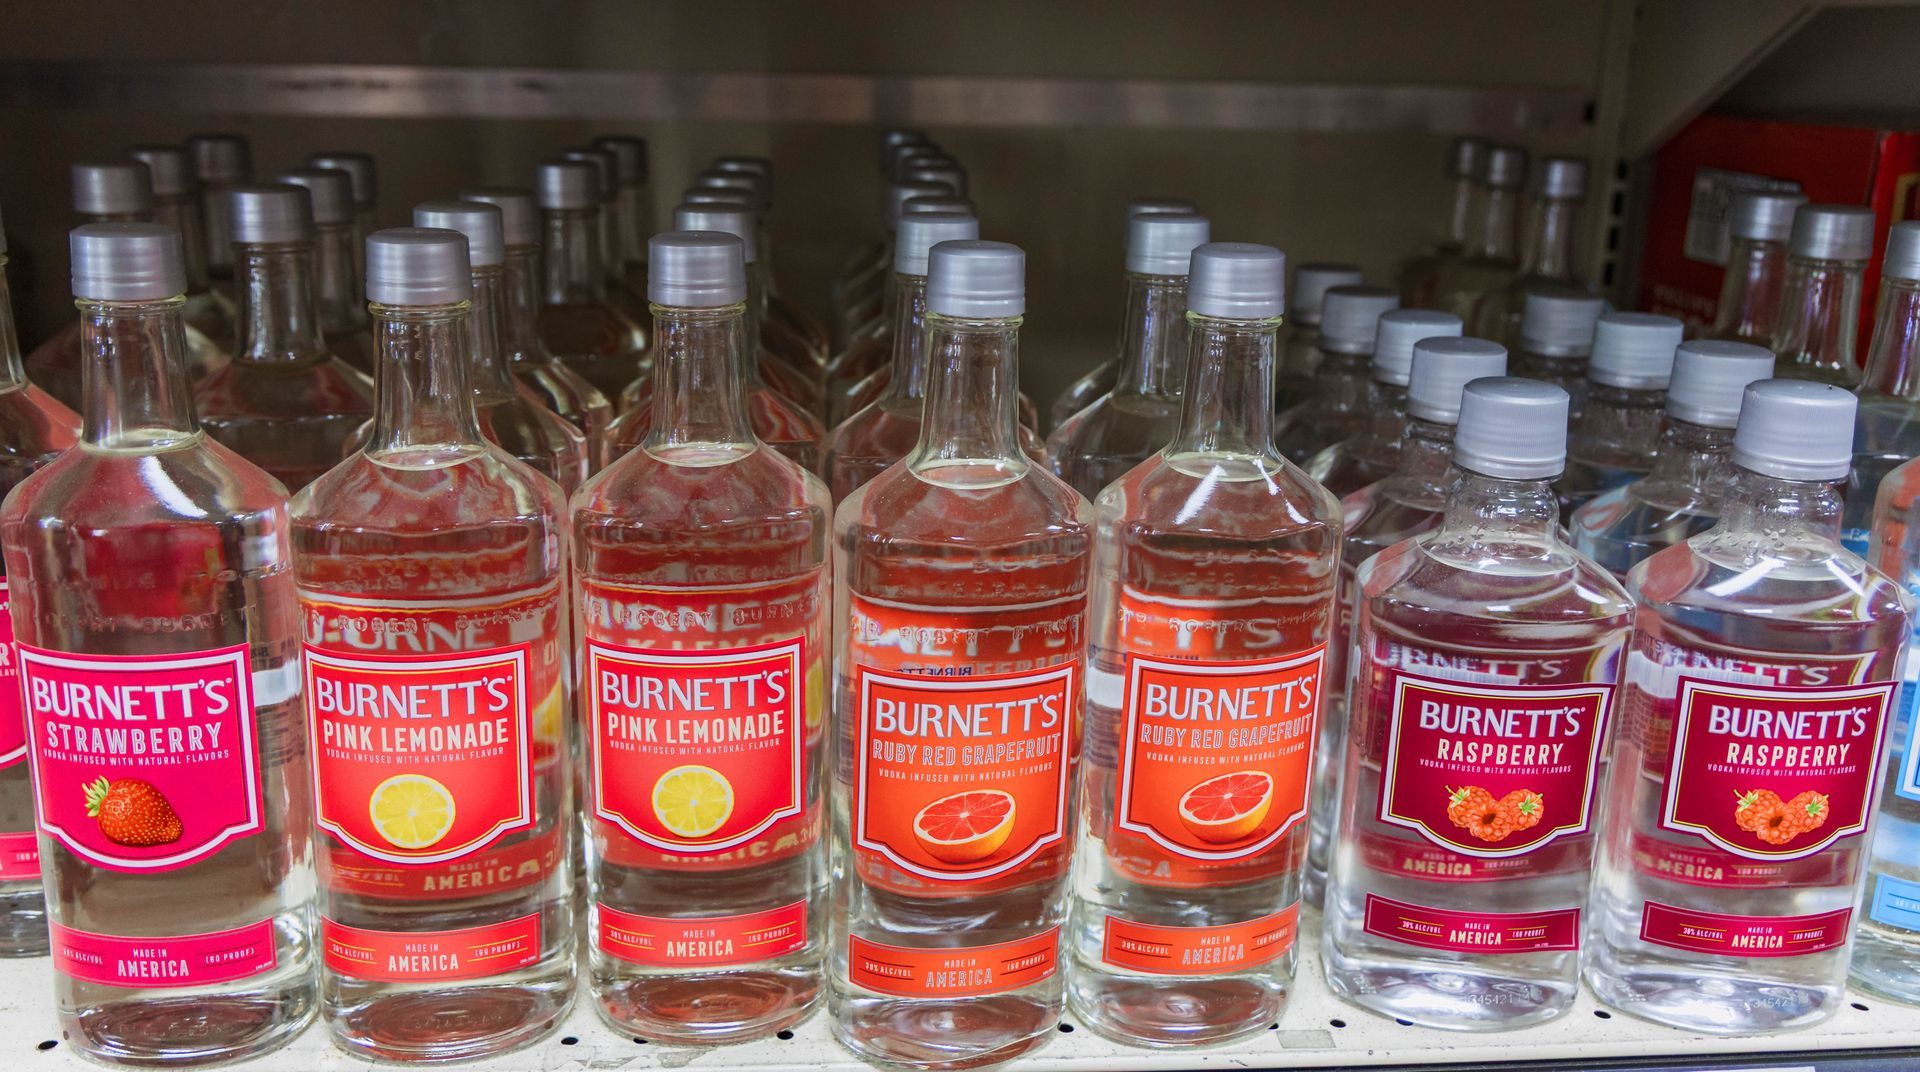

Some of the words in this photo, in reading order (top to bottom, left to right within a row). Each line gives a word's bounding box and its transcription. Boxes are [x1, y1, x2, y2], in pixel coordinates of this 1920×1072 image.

[323, 720, 373, 751] PINK
[382, 718, 509, 752] LEMONADE
[608, 712, 657, 743] PINK
[666, 710, 784, 744] LEMONADE
[1141, 724, 1186, 746] RUBY
[1191, 729, 1223, 748] RED
[1229, 713, 1312, 747] GRAPEFRUIT
[47, 722, 222, 754] STRAWBERRY
[610, 740, 634, 751] VODKA
[639, 744, 675, 755] INFUSED
[679, 747, 702, 755] WITH
[707, 744, 744, 754] NATURAL
[749, 738, 780, 750] FLAVOR
[44, 749, 66, 761] VODKA
[70, 753, 105, 765] INFUSED
[110, 758, 133, 766] WITH
[139, 756, 181, 765] NATURAL
[187, 750, 229, 763] FLAVORS
[327, 748, 350, 760] VODKA
[354, 753, 391, 764] INFUSED
[396, 756, 419, 764] WITH
[425, 753, 465, 763] NATURAL
[470, 747, 503, 759] FLAVOR
[873, 739, 917, 764] RUBY
[922, 746, 955, 766] RED
[962, 733, 1061, 766] GRAPEFRUIT
[1147, 752, 1174, 763] VODKA
[1178, 755, 1215, 765] INFUSED
[1219, 755, 1240, 765] WITH
[1244, 752, 1275, 763] NATURAL
[1278, 742, 1304, 756] FLAVORS
[1437, 739, 1564, 765] RASPBERRY
[1726, 743, 1850, 767] RASPBERRY
[879, 768, 905, 780] VODKA
[910, 772, 948, 783] INFUSED
[953, 773, 975, 782] WITH
[980, 770, 1015, 781] NATURAL
[1020, 762, 1052, 776] FLAVORS
[1420, 758, 1444, 769] VODKA
[1448, 763, 1480, 773] INFUSED
[1484, 766, 1503, 774] WITH
[1542, 765, 1571, 773] FLAVORS
[1708, 763, 1733, 773] VODKA
[1737, 767, 1770, 776] INFUSED
[1829, 765, 1855, 774] FLAVORS
[1403, 857, 1472, 876] AMERICA
[1403, 921, 1414, 929] 30%
[683, 930, 703, 938] MADE
[1201, 936, 1220, 945] MADE
[1449, 930, 1501, 945] AMERICA
[1732, 935, 1782, 948] AMERICA
[133, 948, 155, 957] MADE
[158, 949, 167, 957] IN
[406, 944, 427, 952] MADE
[667, 939, 733, 957] AMERICA
[1122, 941, 1135, 950] 30%
[389, 954, 458, 972] AMERICA
[1182, 944, 1244, 965] AMERICA
[118, 960, 189, 977] AMERICA
[944, 959, 964, 968] MADE
[926, 968, 993, 987] AMERICA
